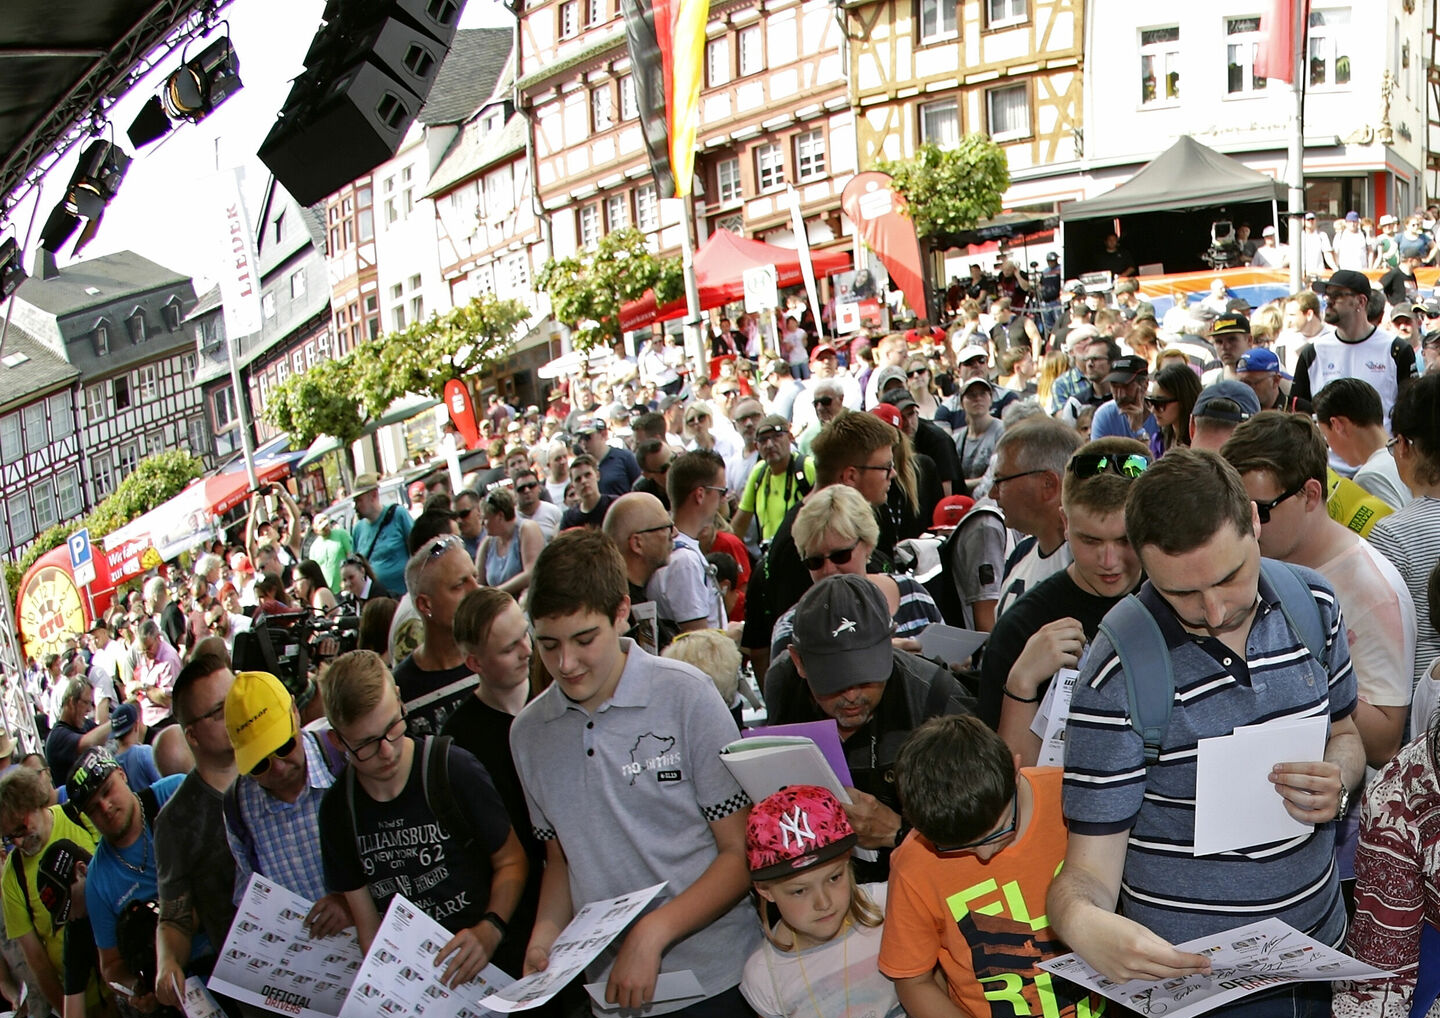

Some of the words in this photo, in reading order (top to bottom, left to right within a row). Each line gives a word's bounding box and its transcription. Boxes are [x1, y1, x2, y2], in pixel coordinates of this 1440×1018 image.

[622, 761, 642, 777] no
[779, 804, 816, 849] NY
[374, 851, 394, 864] NEW
[395, 847, 419, 860] YORK
[260, 984, 312, 1010] OFFICIAL
[264, 996, 303, 1015] DRIVERS
